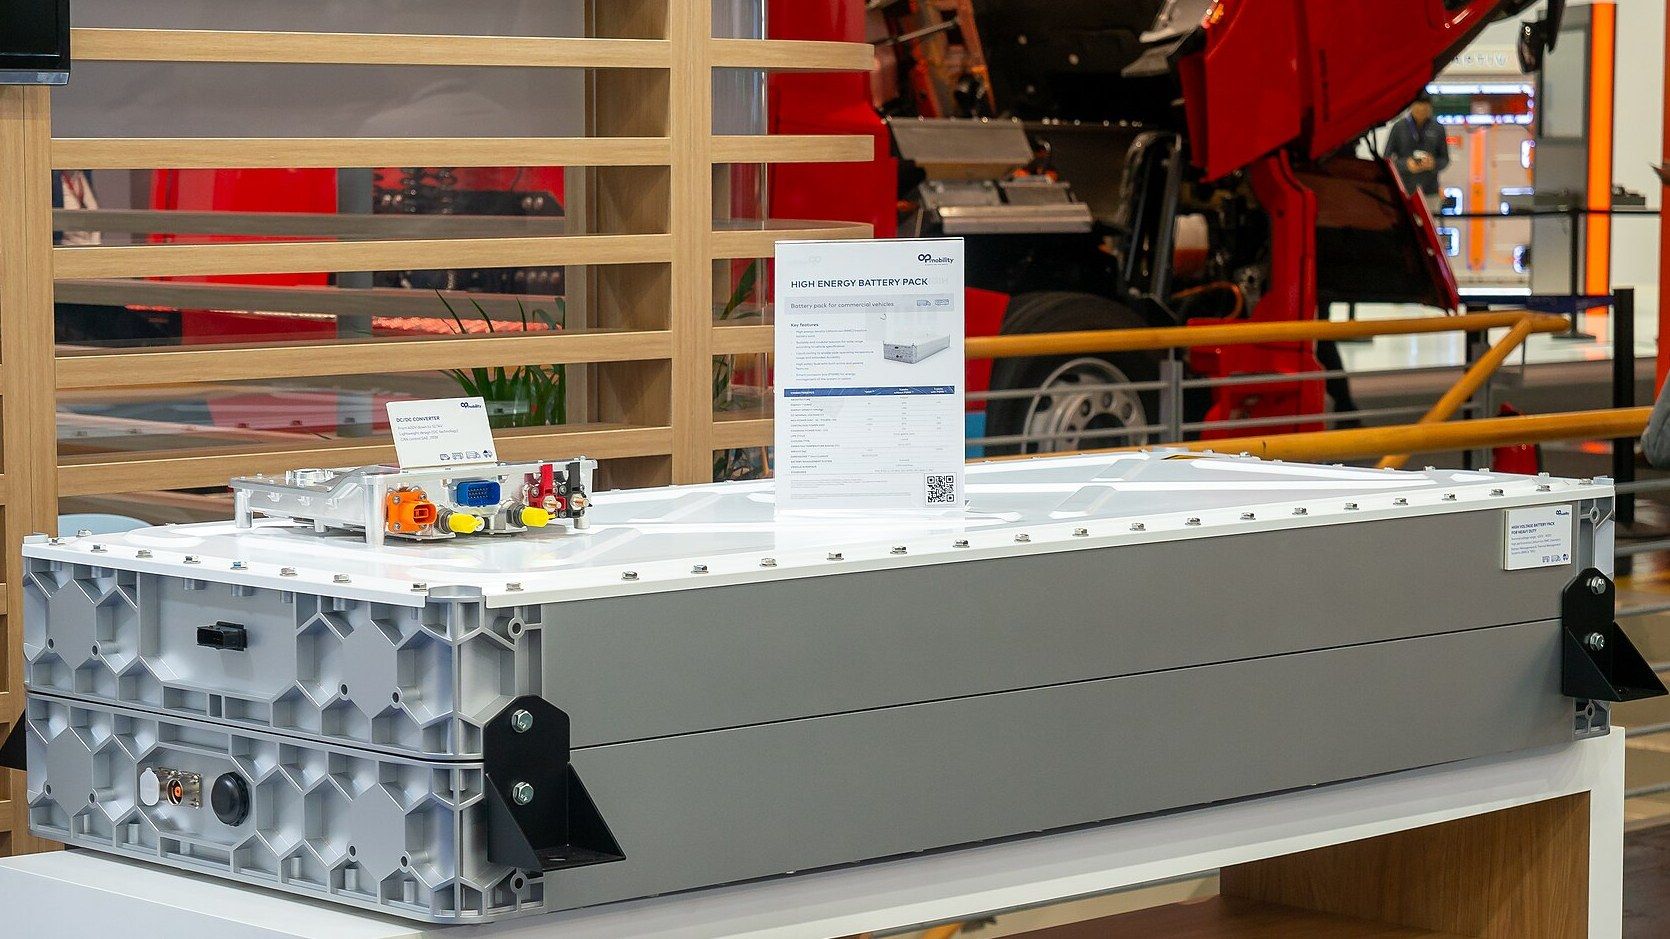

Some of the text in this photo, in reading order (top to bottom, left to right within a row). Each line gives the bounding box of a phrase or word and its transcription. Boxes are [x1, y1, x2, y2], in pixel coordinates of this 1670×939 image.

[790, 278, 928, 288] HIGH ENERGY BATTERY PACK
